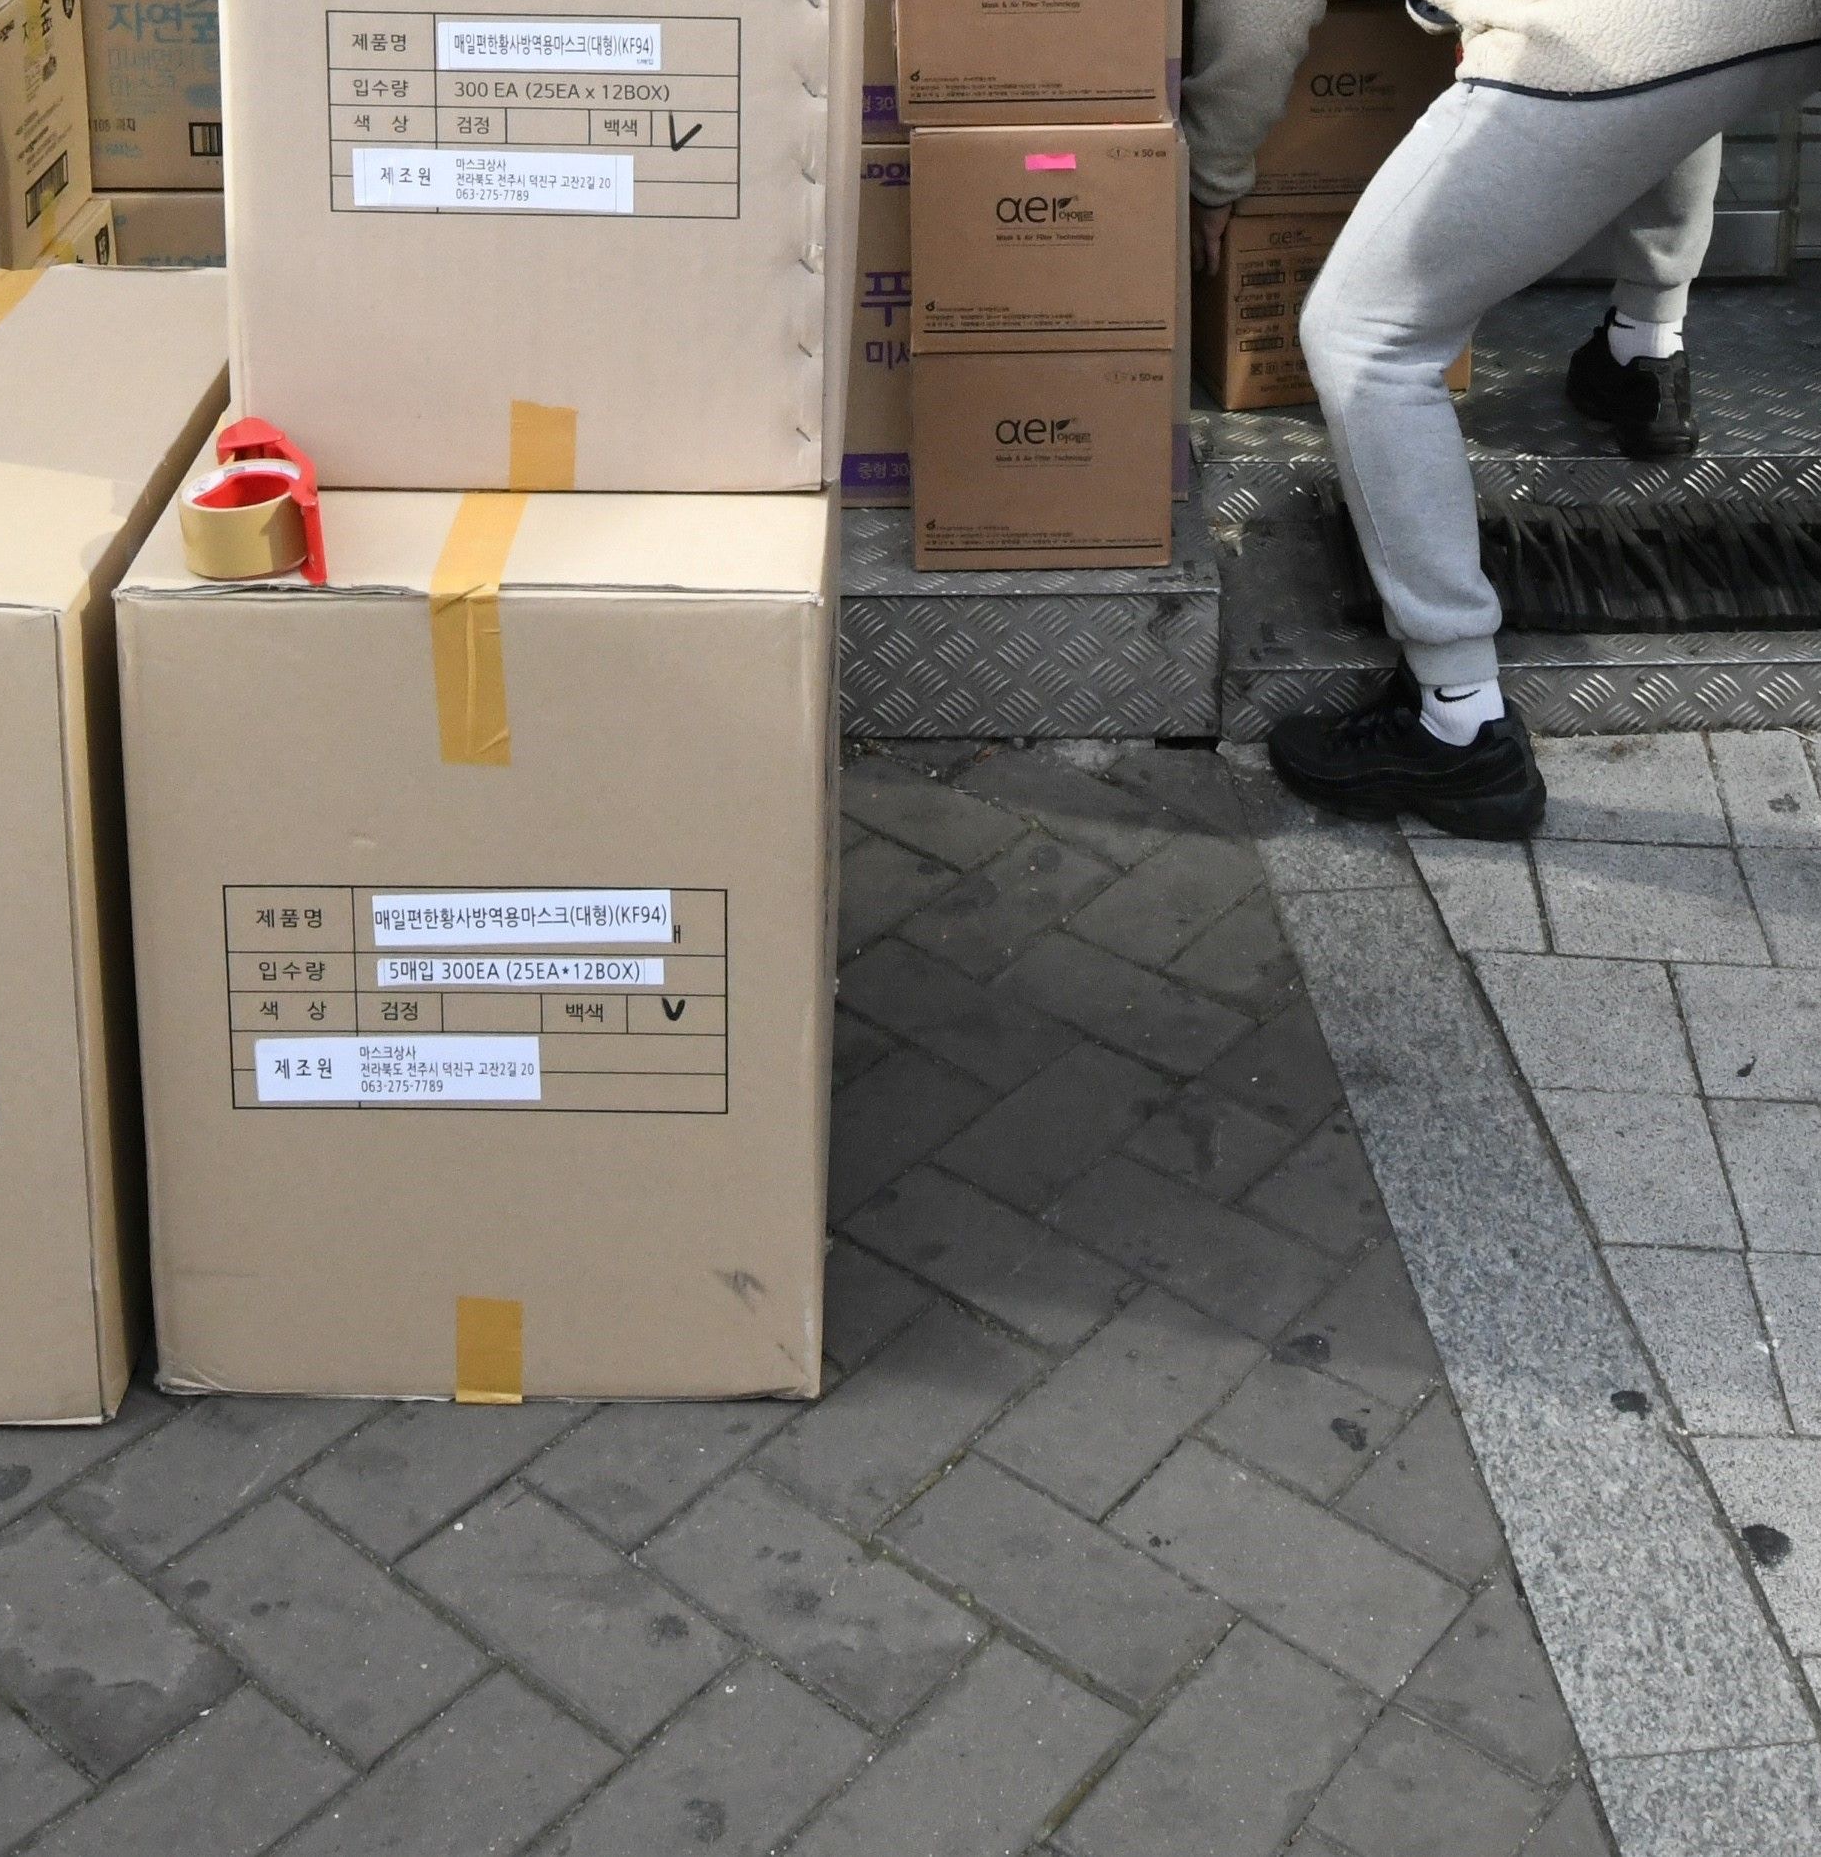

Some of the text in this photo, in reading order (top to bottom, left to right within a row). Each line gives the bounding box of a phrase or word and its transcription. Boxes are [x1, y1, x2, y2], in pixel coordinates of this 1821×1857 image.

[351, 32, 655, 57] 제품명 매일편한황사방역용마스크(대형)(KF94)
[352, 78, 671, 103] 입수량 300 EA (25EA x 12BOX)
[456, 114, 639, 138] 검정 백색
[379, 166, 432, 186] 제조원
[455, 158, 507, 171] 마스크상사
[455, 173, 494, 187] 전라북도
[497, 174, 526, 188] 전주시
[529, 175, 557, 189] 덕진구
[598, 177, 611, 189] 20
[455, 189, 530, 202] 063-275-7789
[996, 196, 1072, 224] aer
[374, 902, 668, 930] 매일편한황사방역용마스크(대형)(KF94)
[258, 960, 326, 983] 입수량
[388, 960, 435, 983] 5매입
[441, 961, 501, 981] 300EA
[360, 1079, 445, 1094] 063-275-7789
